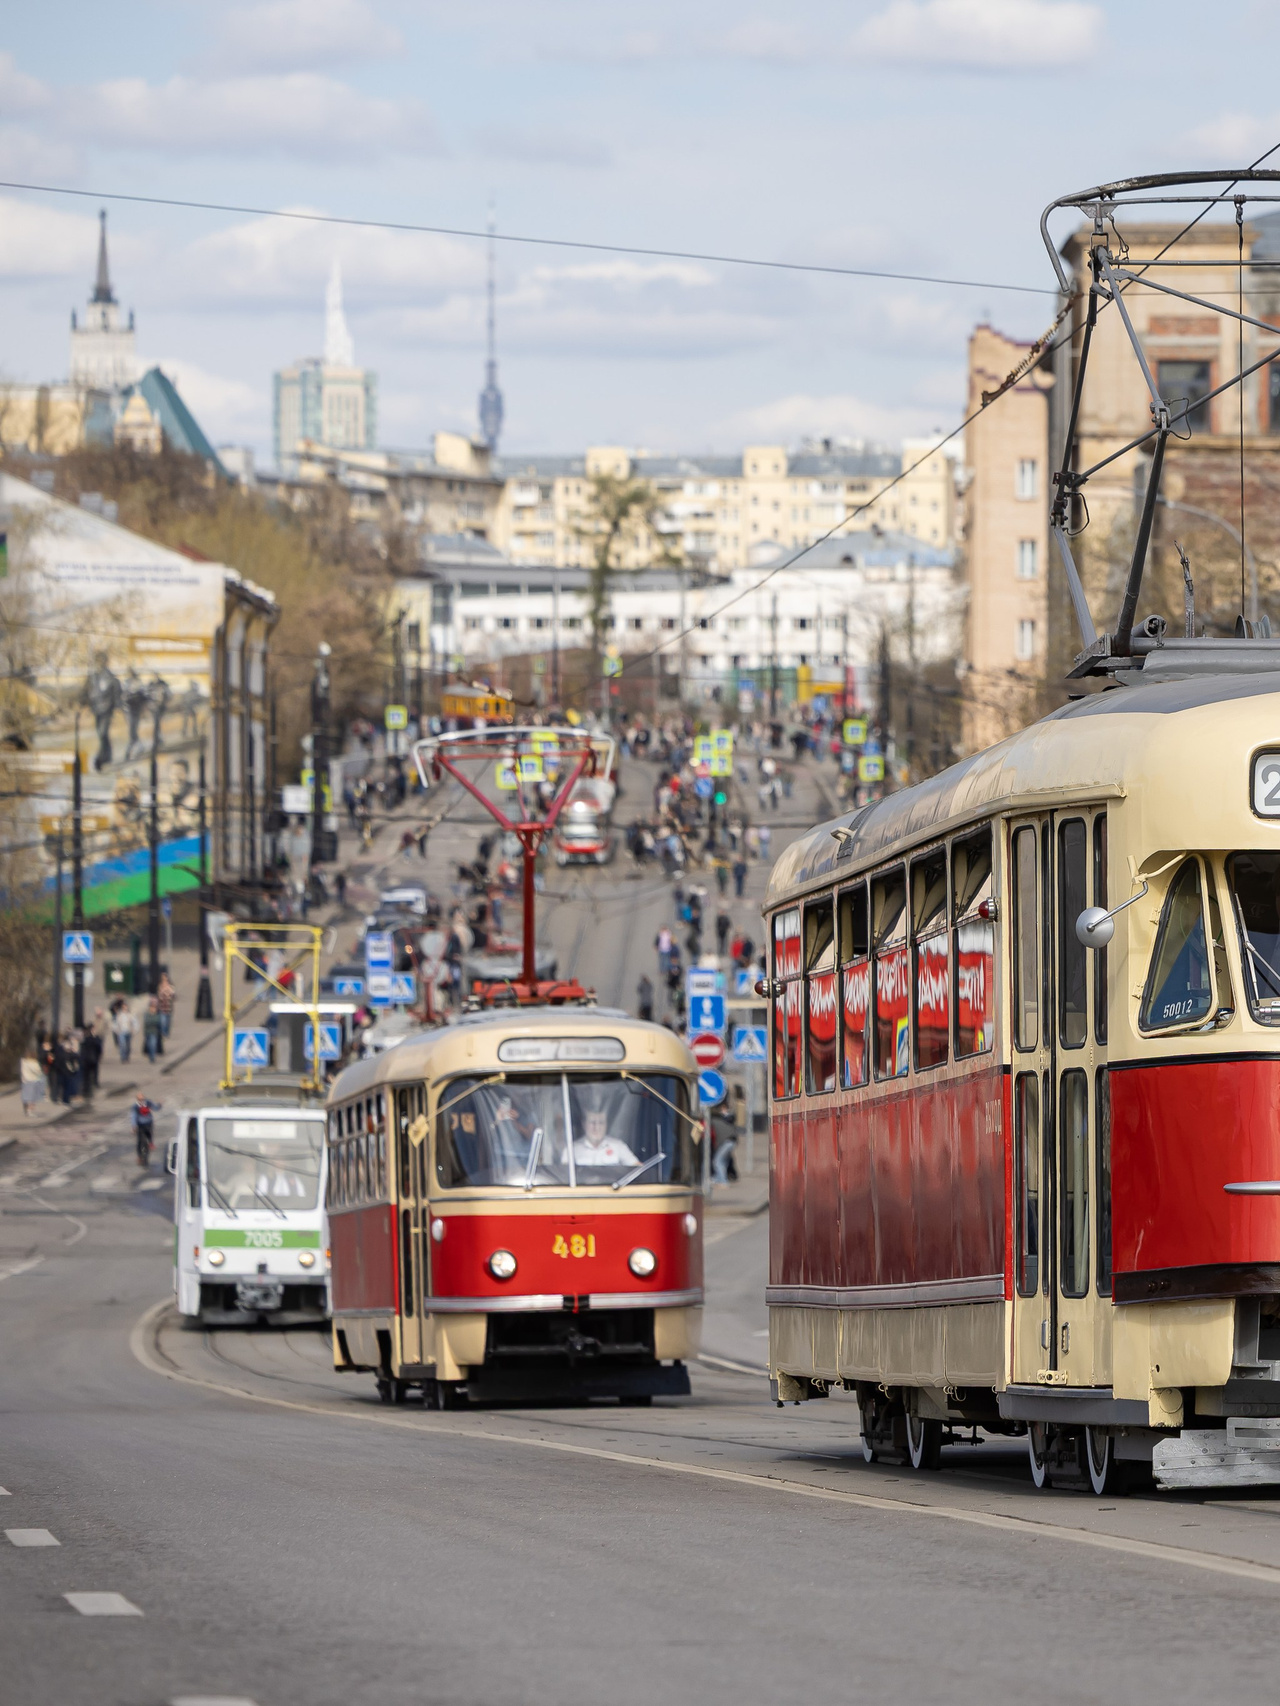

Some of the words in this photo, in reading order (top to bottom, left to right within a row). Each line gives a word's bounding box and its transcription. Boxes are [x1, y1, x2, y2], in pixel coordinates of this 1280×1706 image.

[1163, 999, 1193, 1019] 50012
[244, 1229, 284, 1248] 7005
[552, 1233, 597, 1259] 481
